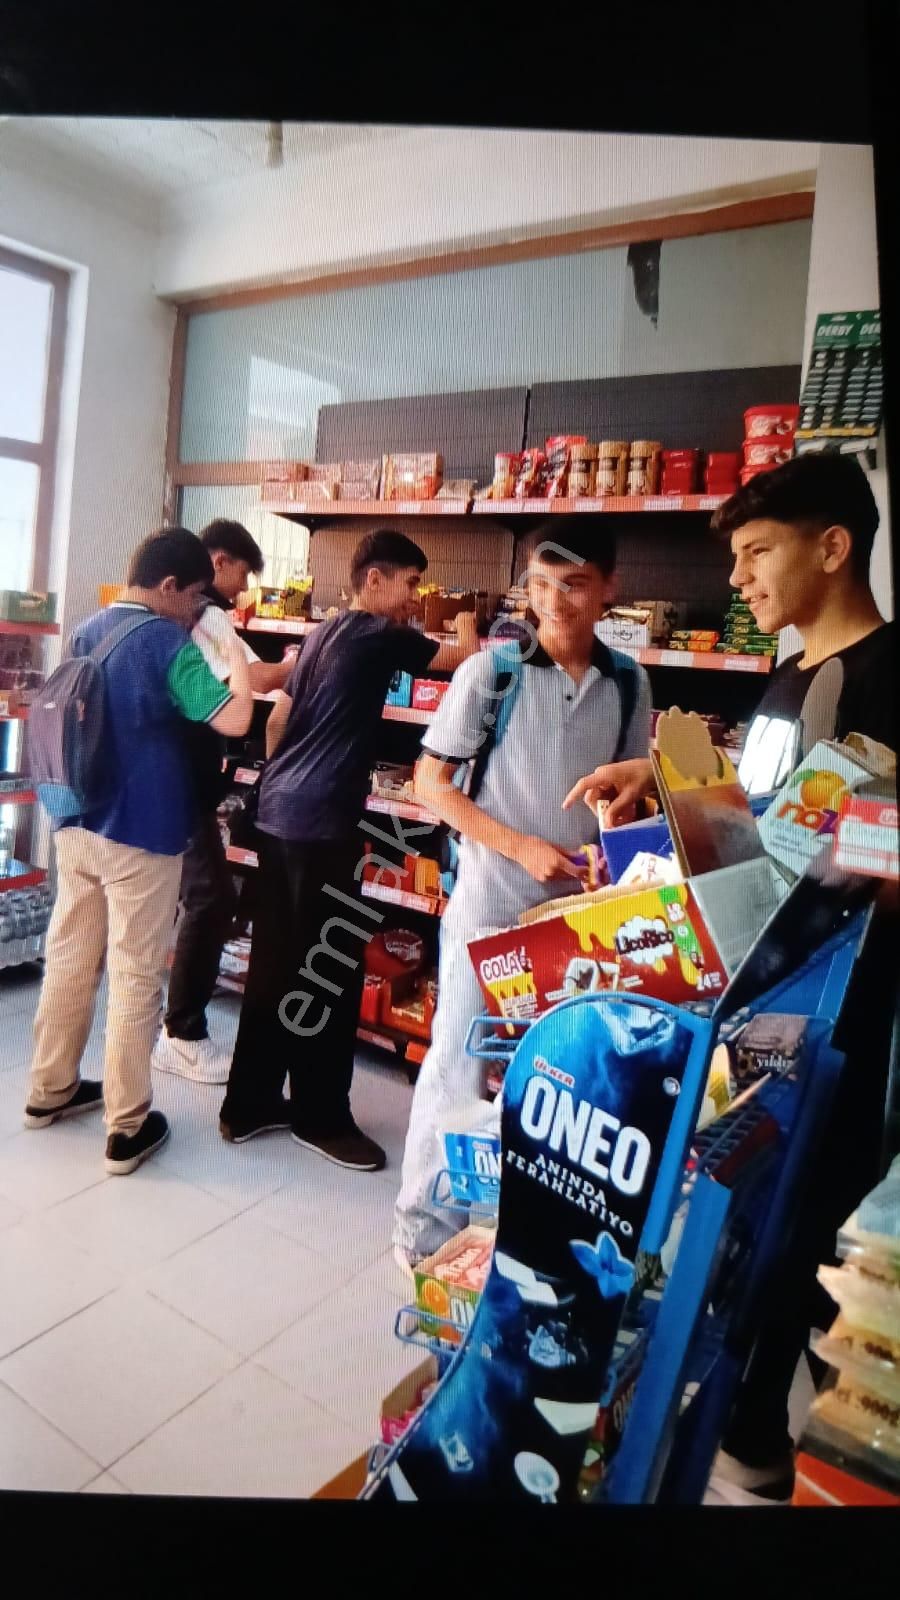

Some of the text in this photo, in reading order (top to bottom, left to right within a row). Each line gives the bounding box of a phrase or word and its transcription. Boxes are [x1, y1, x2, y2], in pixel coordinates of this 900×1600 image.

[816, 324, 854, 337] DERBY
[482, 950, 521, 982] COLA
[534, 1058, 575, 1087] ÜLKER
[520, 1076, 651, 1195] ONEO
[506, 1149, 634, 1238] FERAHLATIYO
[535, 1153, 607, 1206] ANINDA
